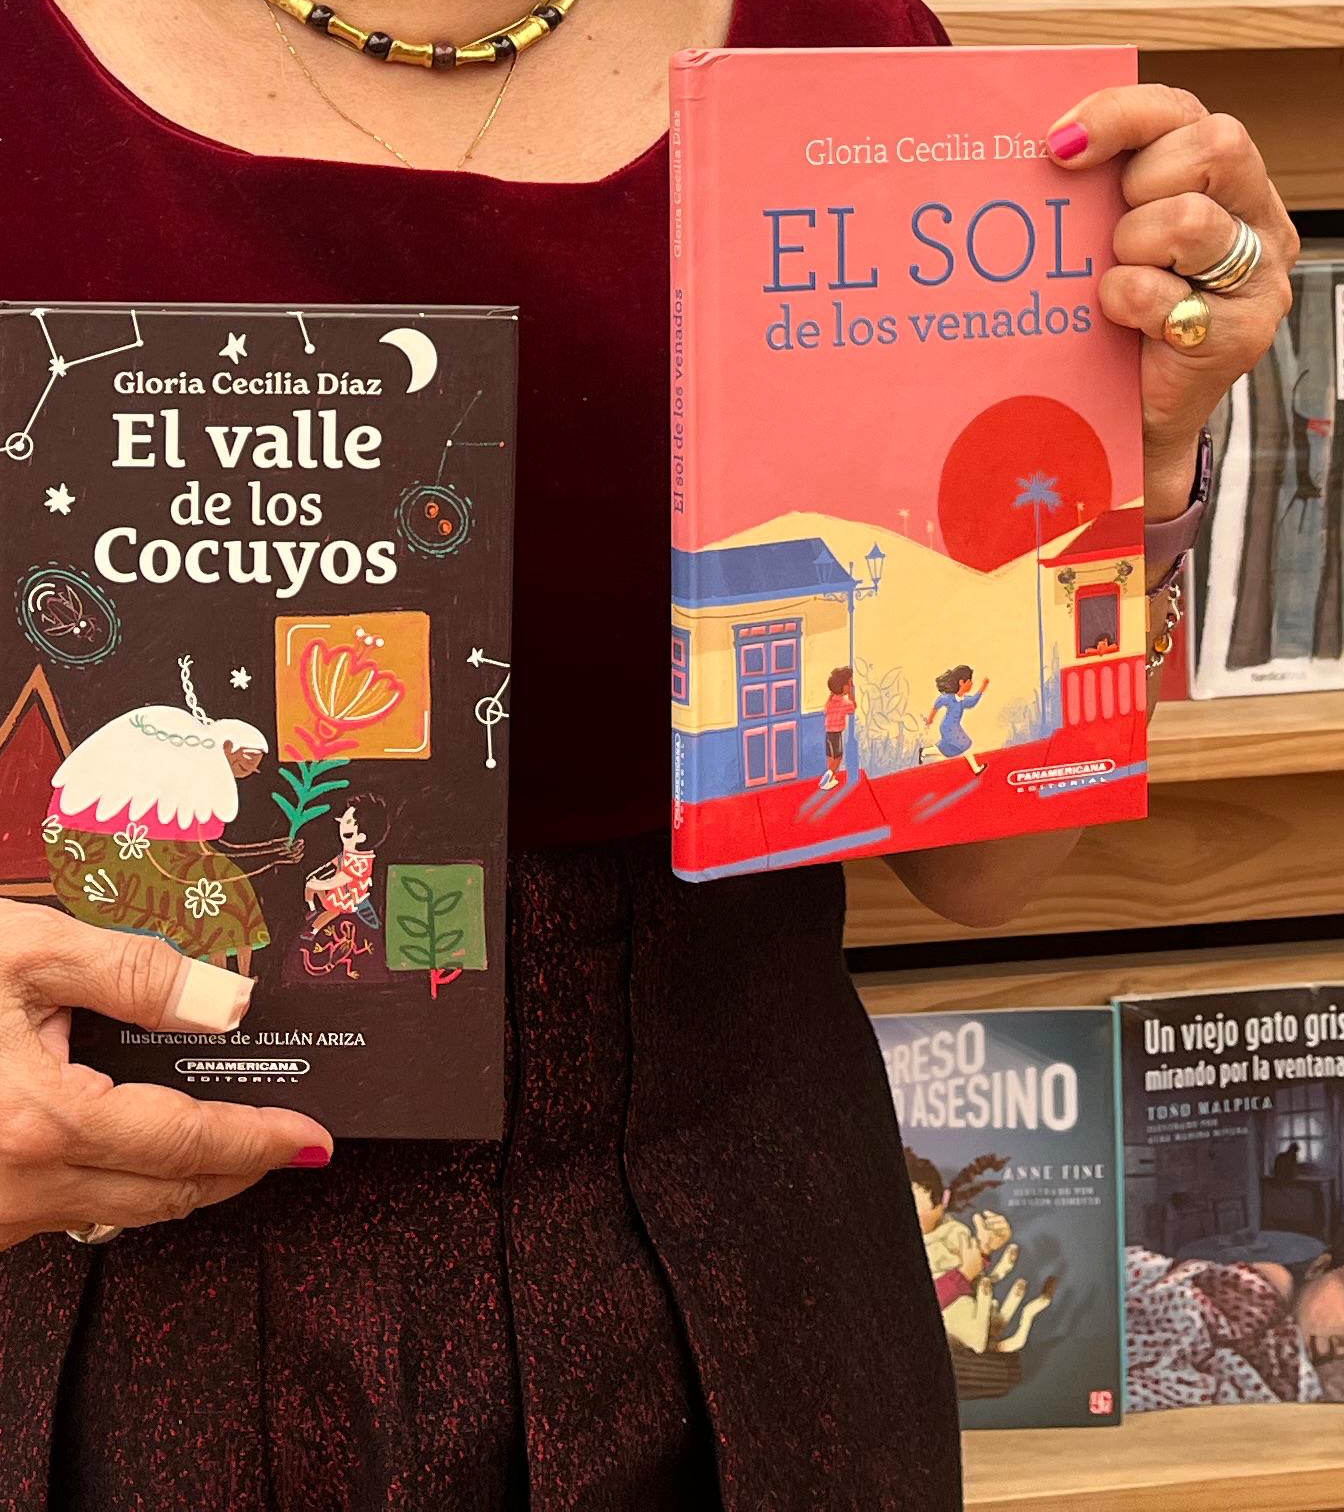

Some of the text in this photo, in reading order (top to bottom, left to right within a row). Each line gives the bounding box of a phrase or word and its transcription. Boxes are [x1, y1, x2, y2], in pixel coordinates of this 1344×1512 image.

[805, 132, 1048, 167] Gloria Cecilia Díaz
[762, 198, 1093, 293] EL SOL
[674, 289, 685, 379] venados
[766, 290, 1092, 351] de los venados
[113, 372, 382, 396] Gloria Cecilia Díaz
[111, 409, 383, 469] El valle
[171, 481, 323, 526] de los
[94, 527, 398, 599] Cocuyos
[1015, 759, 1108, 783] PANAMERICANA
[1016, 774, 1108, 794] EDITORIAL
[120, 1028, 366, 1047] Ilustraciones de JULIÁN ARIZA
[1144, 1017, 1175, 1056] Un
[1180, 1014, 1239, 1058] viejo
[1246, 1011, 1298, 1053] gato
[186, 1059, 299, 1072] PANAMERICANA
[1145, 1061, 1217, 1091] mirando
[1220, 1063, 1248, 1088] por
[1252, 1054, 1270, 1083] la
[911, 1062, 1078, 1131] ASESINO
